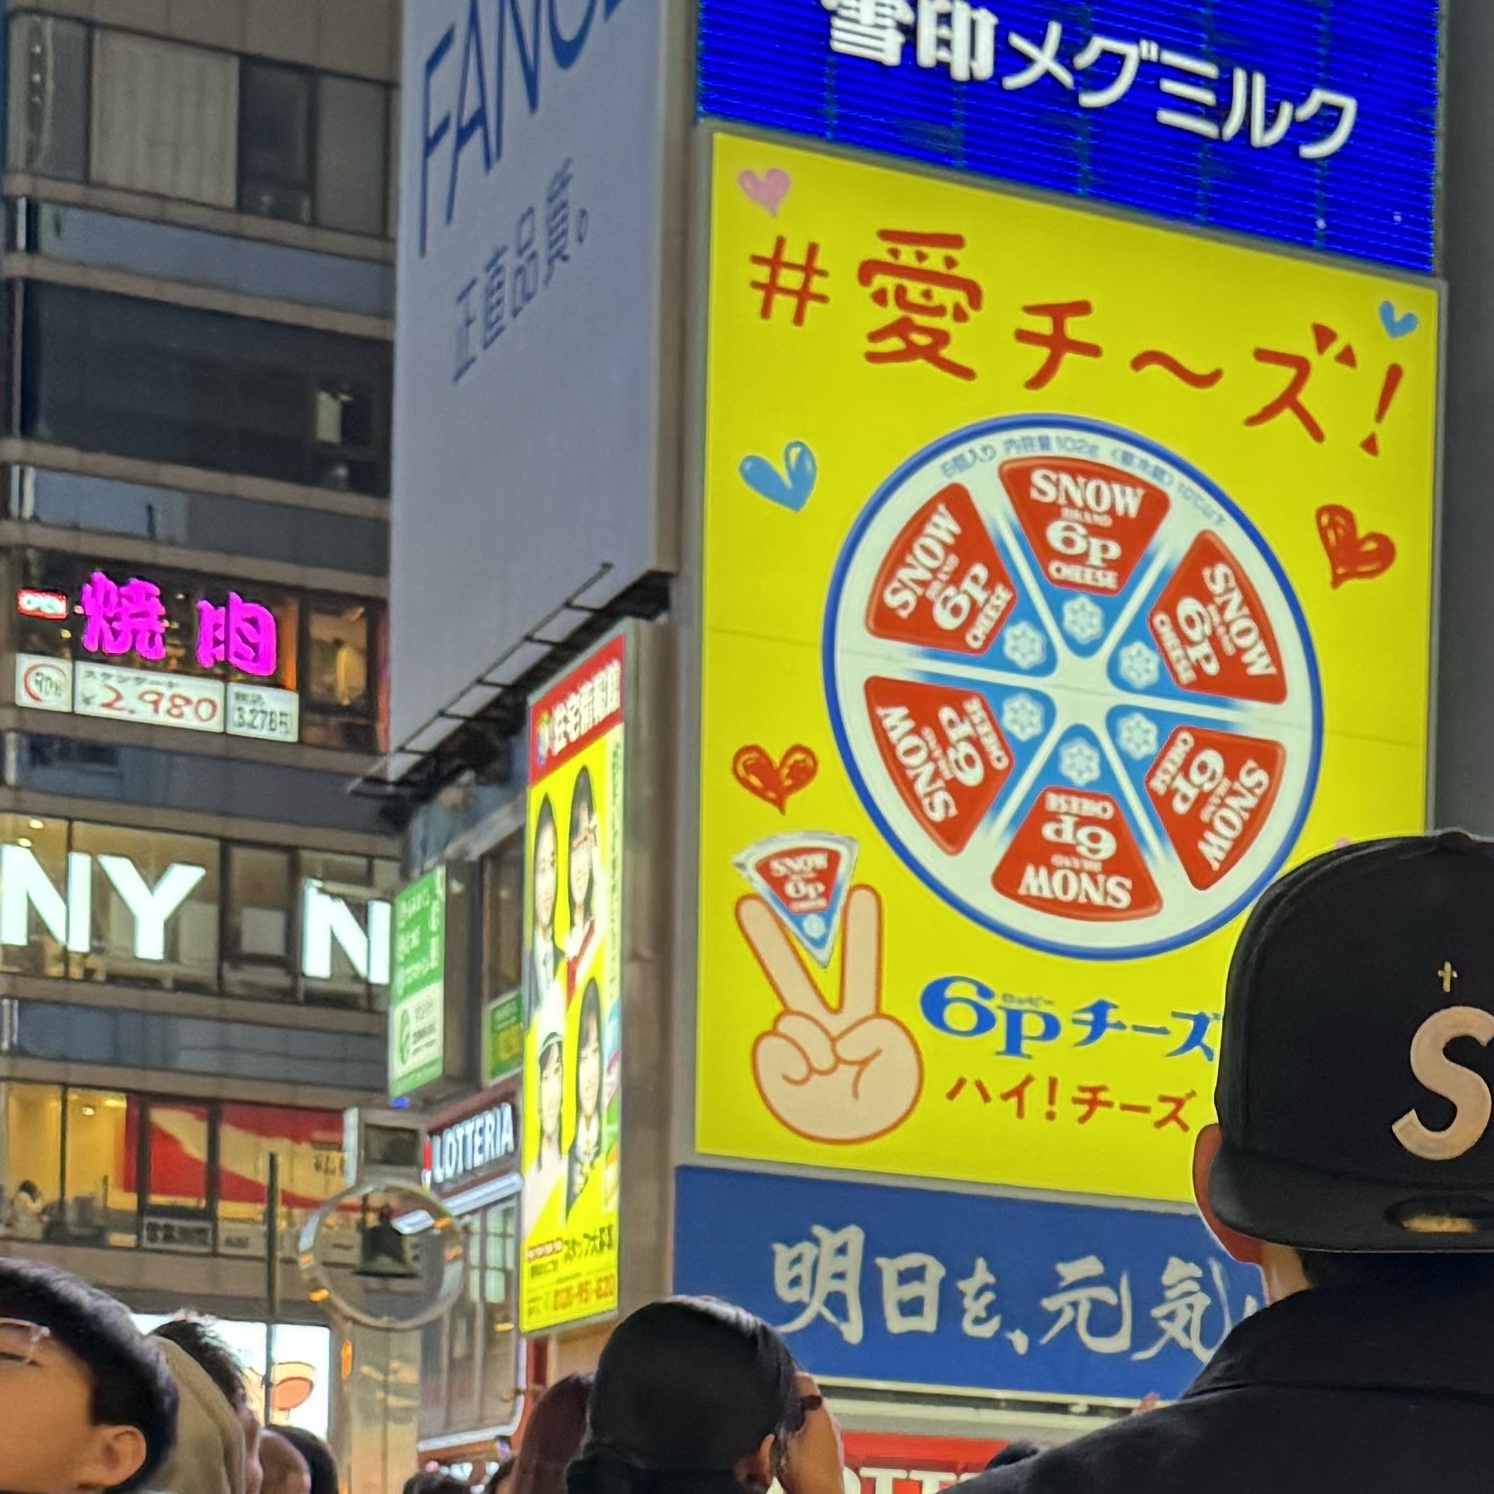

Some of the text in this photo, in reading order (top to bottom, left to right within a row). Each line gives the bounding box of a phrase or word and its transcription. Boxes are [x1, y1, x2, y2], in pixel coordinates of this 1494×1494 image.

[417, 0, 625, 258] FAN
[821, 0, 1358, 159] 雪印メグミルク
[1030, 468, 1147, 519] SNOW
[883, 502, 962, 619] SNOW
[81, 571, 277, 677] 焼肉
[1202, 563, 1277, 677] SNOW
[875, 706, 959, 822] SNOW
[1198, 759, 1270, 871] SNOW
[769, 852, 828, 877] SNOW
[1017, 862, 1133, 910] SNOW
[433, 1102, 515, 1184] LOTTERIA
[772, 1224, 1258, 1365] 明日を、元気
